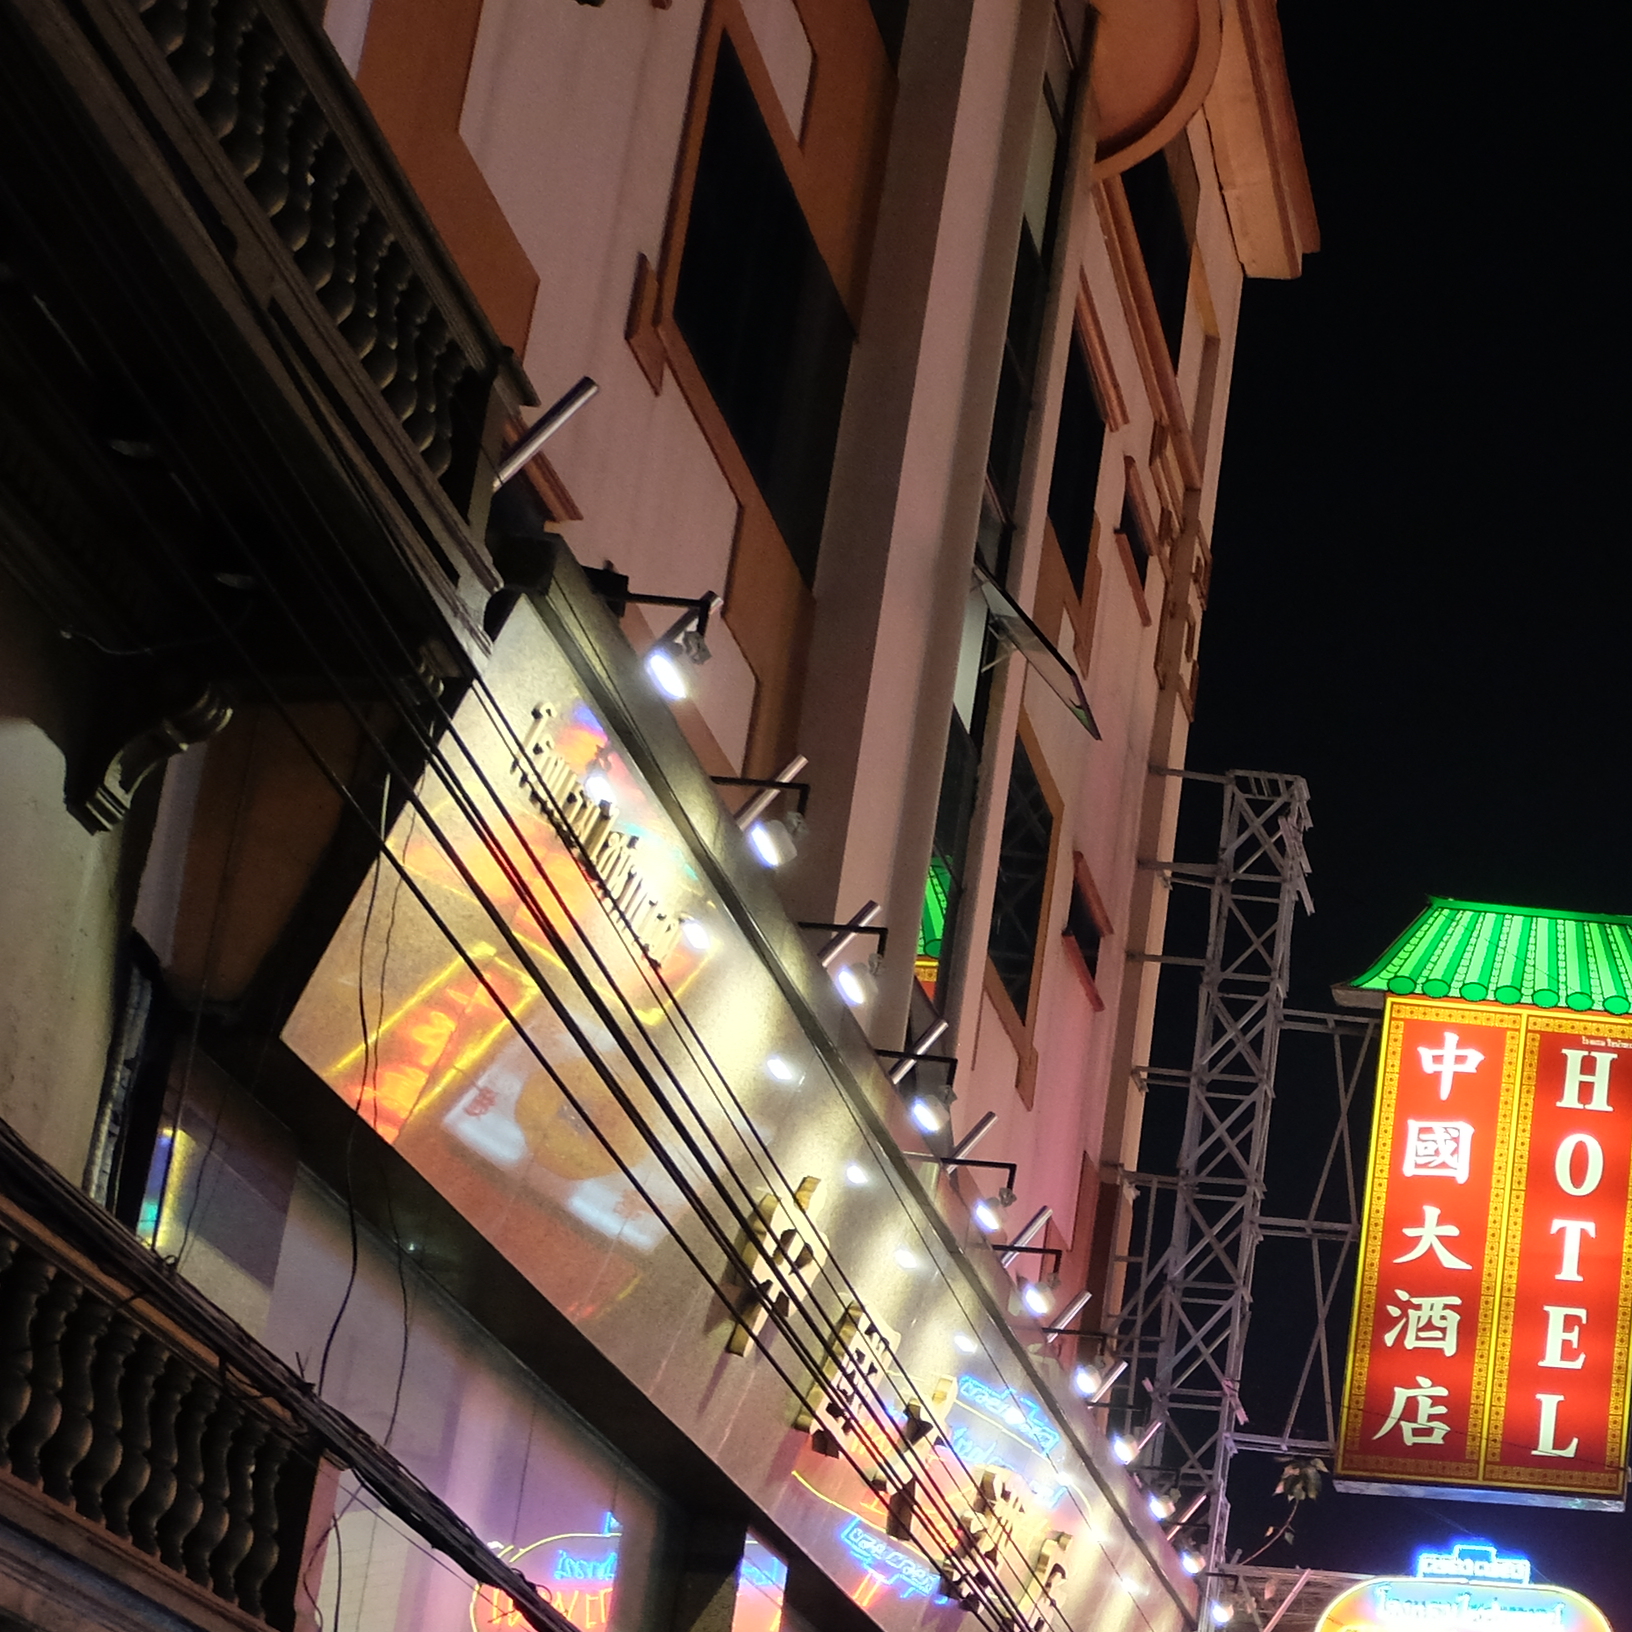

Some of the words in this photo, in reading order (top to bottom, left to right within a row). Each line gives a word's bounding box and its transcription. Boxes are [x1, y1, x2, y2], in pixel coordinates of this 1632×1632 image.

[1373, 1031, 1485, 1446] 中國大酒店
[1531, 1048, 1618, 1459] HOTEL
